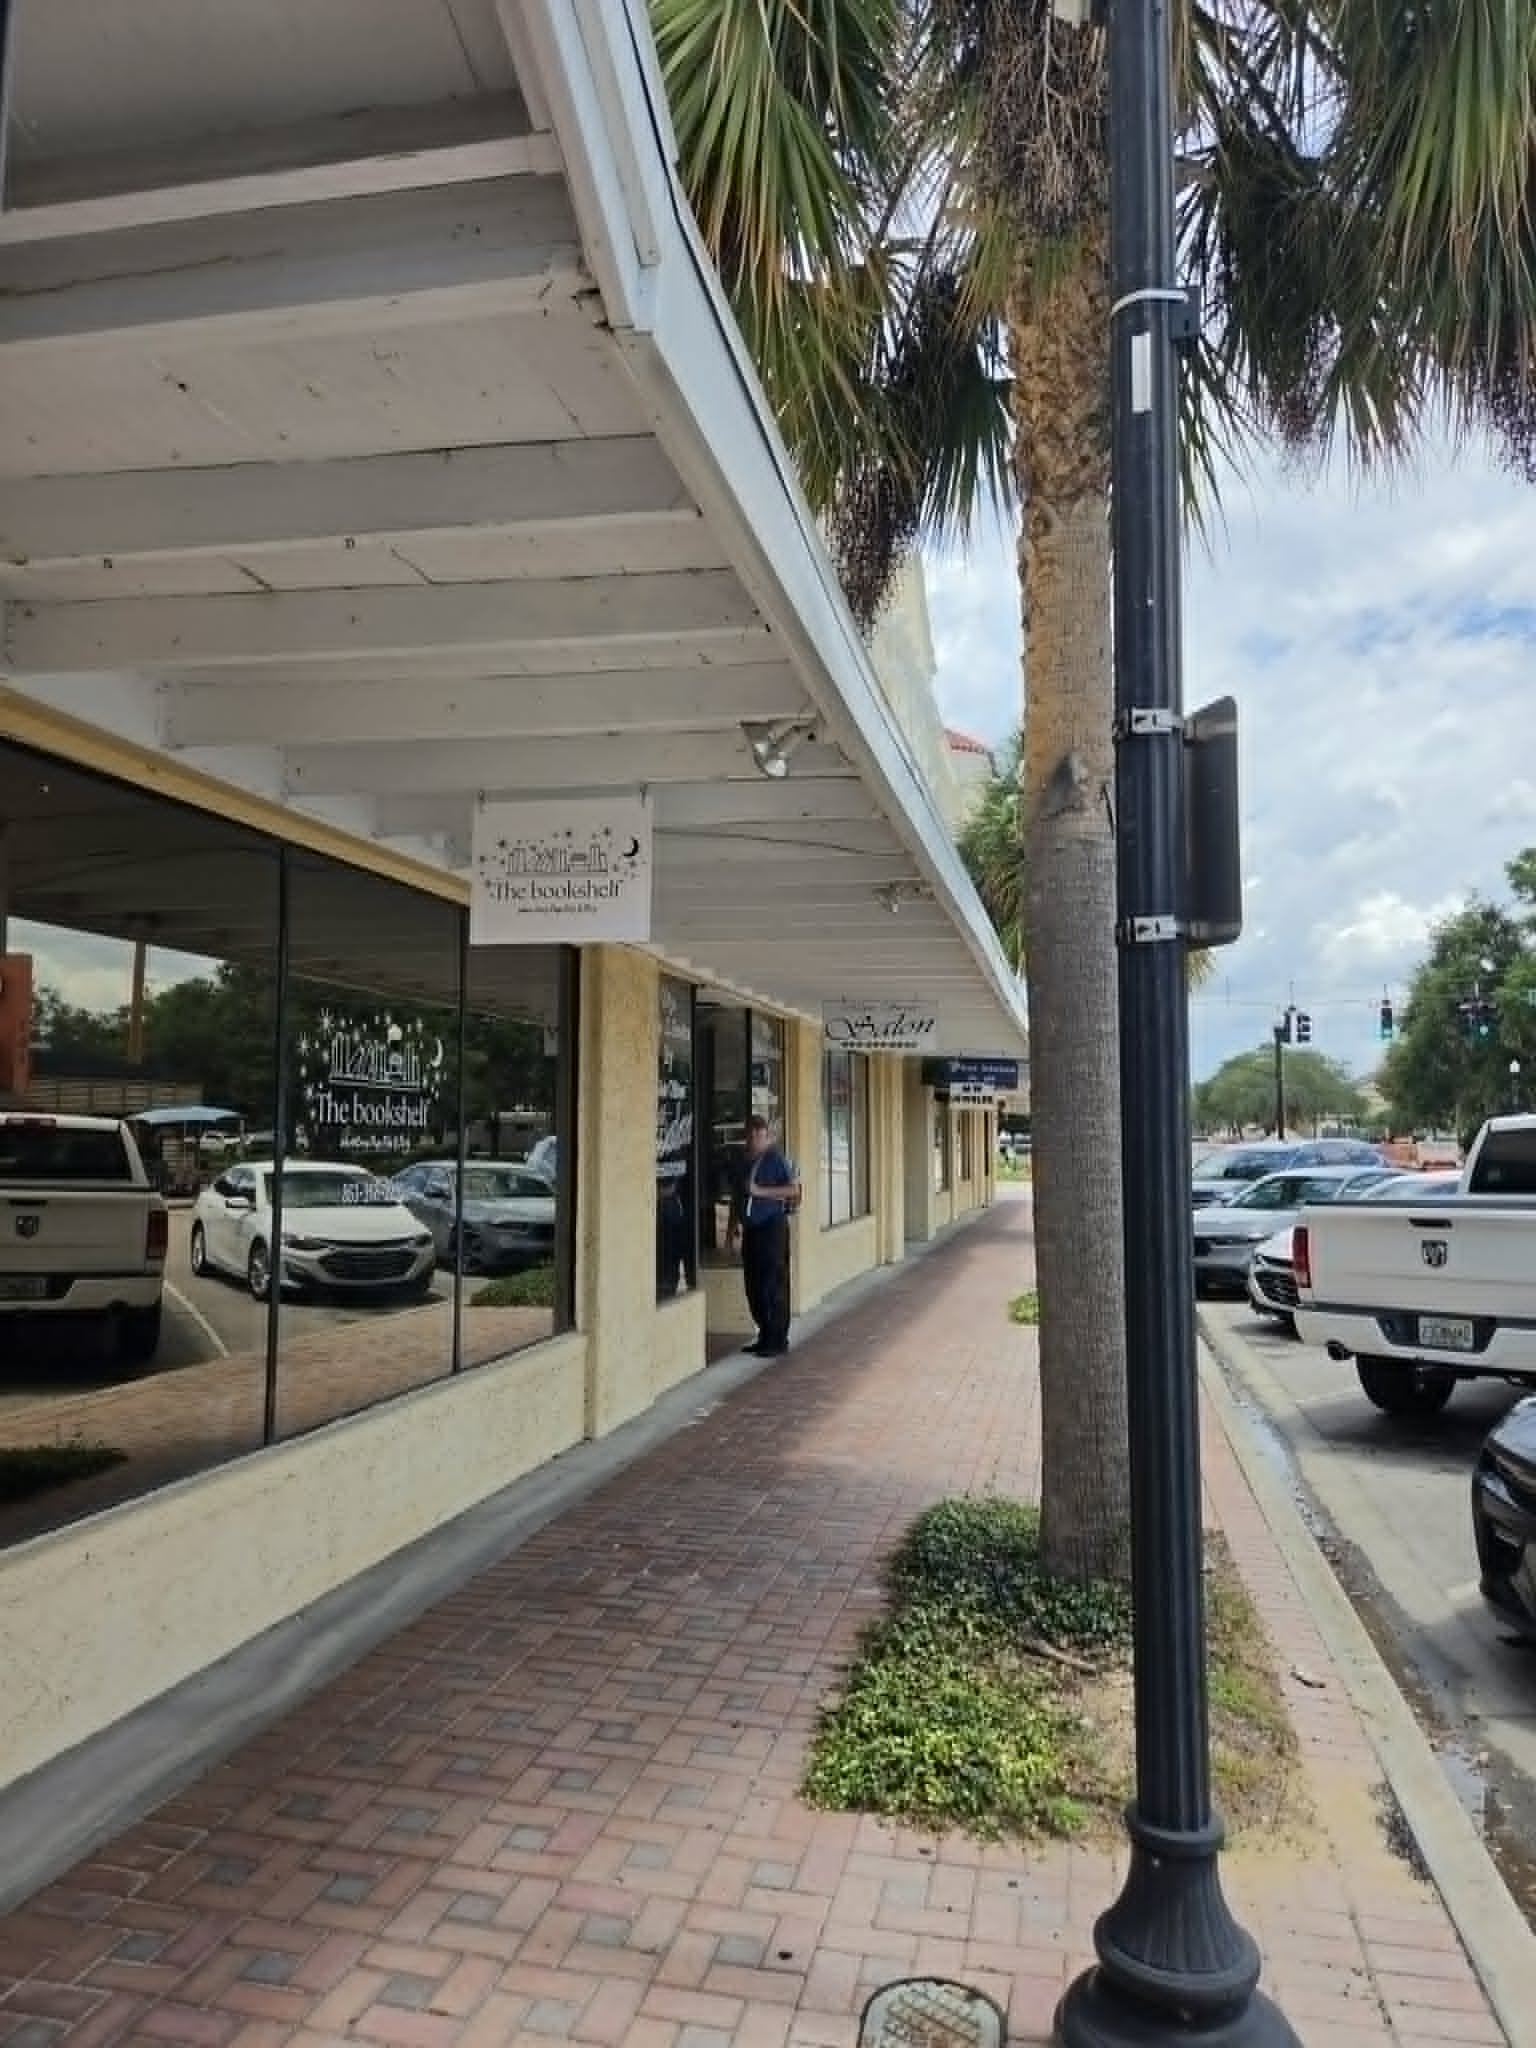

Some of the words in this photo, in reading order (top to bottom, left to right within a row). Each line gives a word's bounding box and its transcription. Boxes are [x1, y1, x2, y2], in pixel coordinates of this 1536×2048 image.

[494, 879, 527, 901] The
[531, 877, 624, 898] bookshelf
[316, 1091, 350, 1124] The
[352, 1093, 430, 1128] bookshelf
